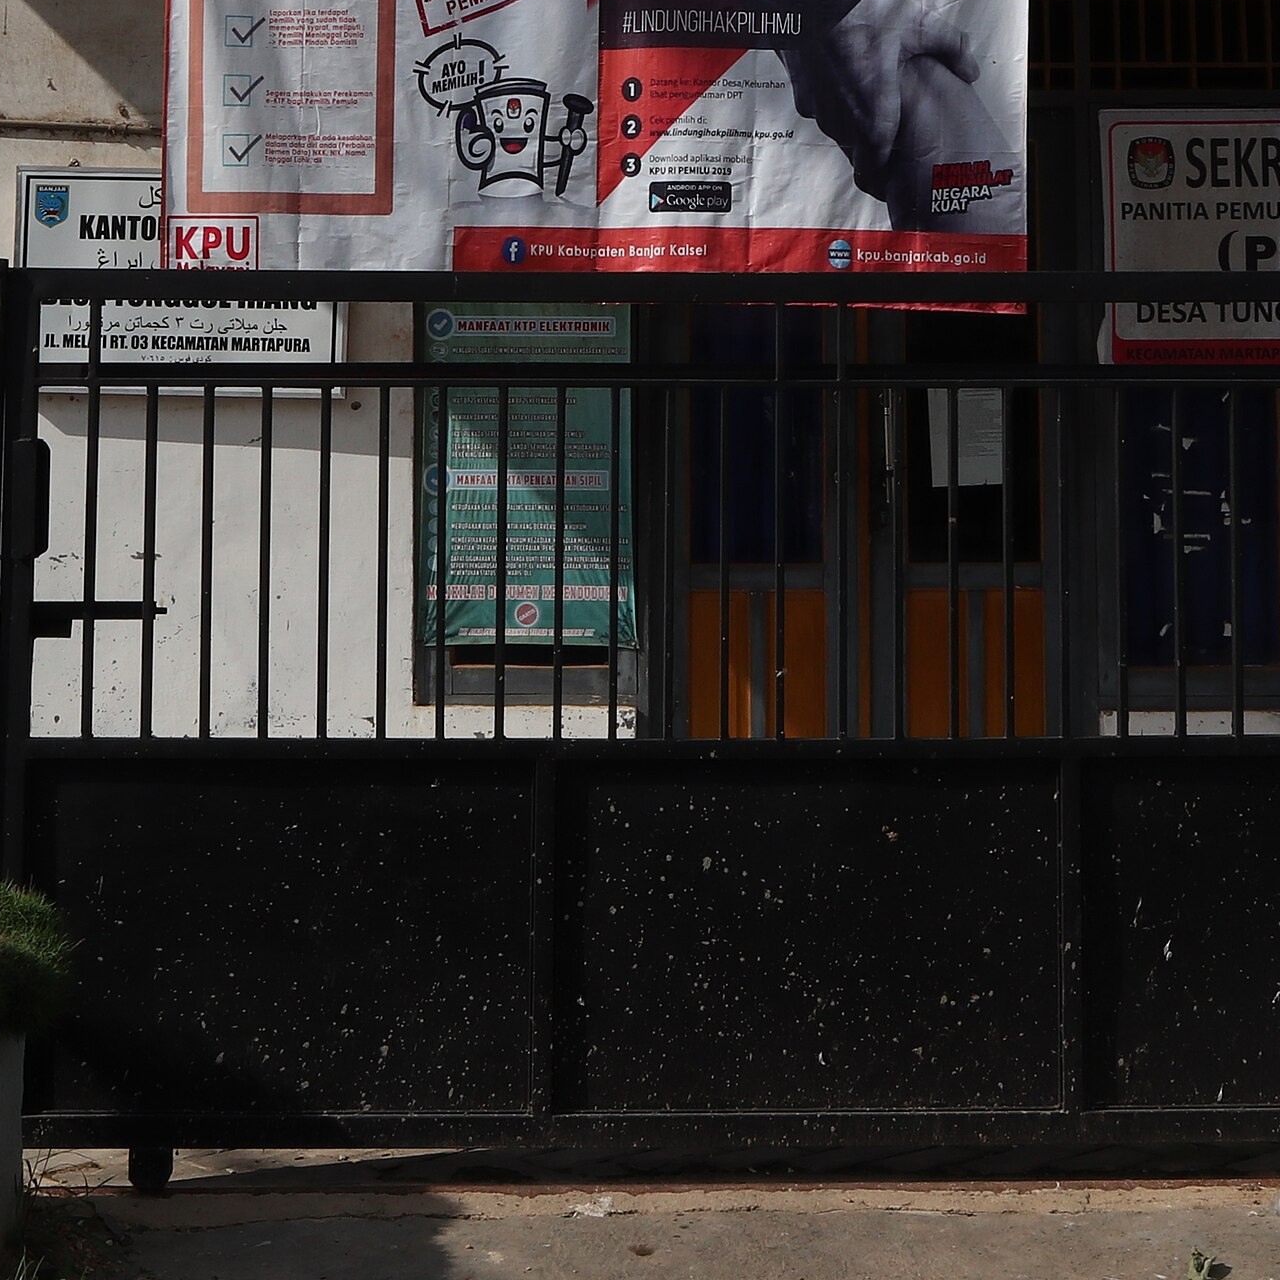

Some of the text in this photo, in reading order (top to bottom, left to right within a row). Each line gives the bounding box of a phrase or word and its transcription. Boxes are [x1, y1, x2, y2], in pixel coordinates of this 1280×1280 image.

[622, 11, 801, 36] #LINDUNGIHAKPILIHMU
[441, 60, 466, 79] AYO
[432, 60, 485, 94] MEMILIH!
[650, 78, 678, 88] Datang
[722, 79, 786, 89] Desa/Kelurahan
[628, 83, 635, 97] 1
[670, 91, 744, 101] pengumuman DPT
[627, 120, 636, 134] 2
[649, 116, 696, 126] Cek pemilih
[626, 158, 636, 172] 3
[649, 154, 753, 165] Download aplikasi mobile:
[649, 167, 732, 176] KPU RI PEMILU 2019
[931, 185, 991, 200] NEGARA
[666, 194, 729, 210] Google play
[931, 199, 968, 213] KUAT
[1121, 202, 1209, 220] PANITIA
[79, 214, 161, 241] KANTO
[175, 226, 251, 261] KPU
[530, 243, 708, 260] KPU Kabupaten Banjar Kalsel
[857, 249, 987, 266] kpu.banjarkab.go.id
[1136, 302, 1207, 324] DESA
[458, 321, 610, 332] MANFAAT KTP ELEKTRONIK
[44, 334, 311, 353] JL. MELI RT. 03 KECAMATAN MARTAPURA
[1125, 347, 1216, 361] KECAMATAN
[457, 476, 496, 485] MANFAAT
[580, 476, 602, 485] SIPIL
